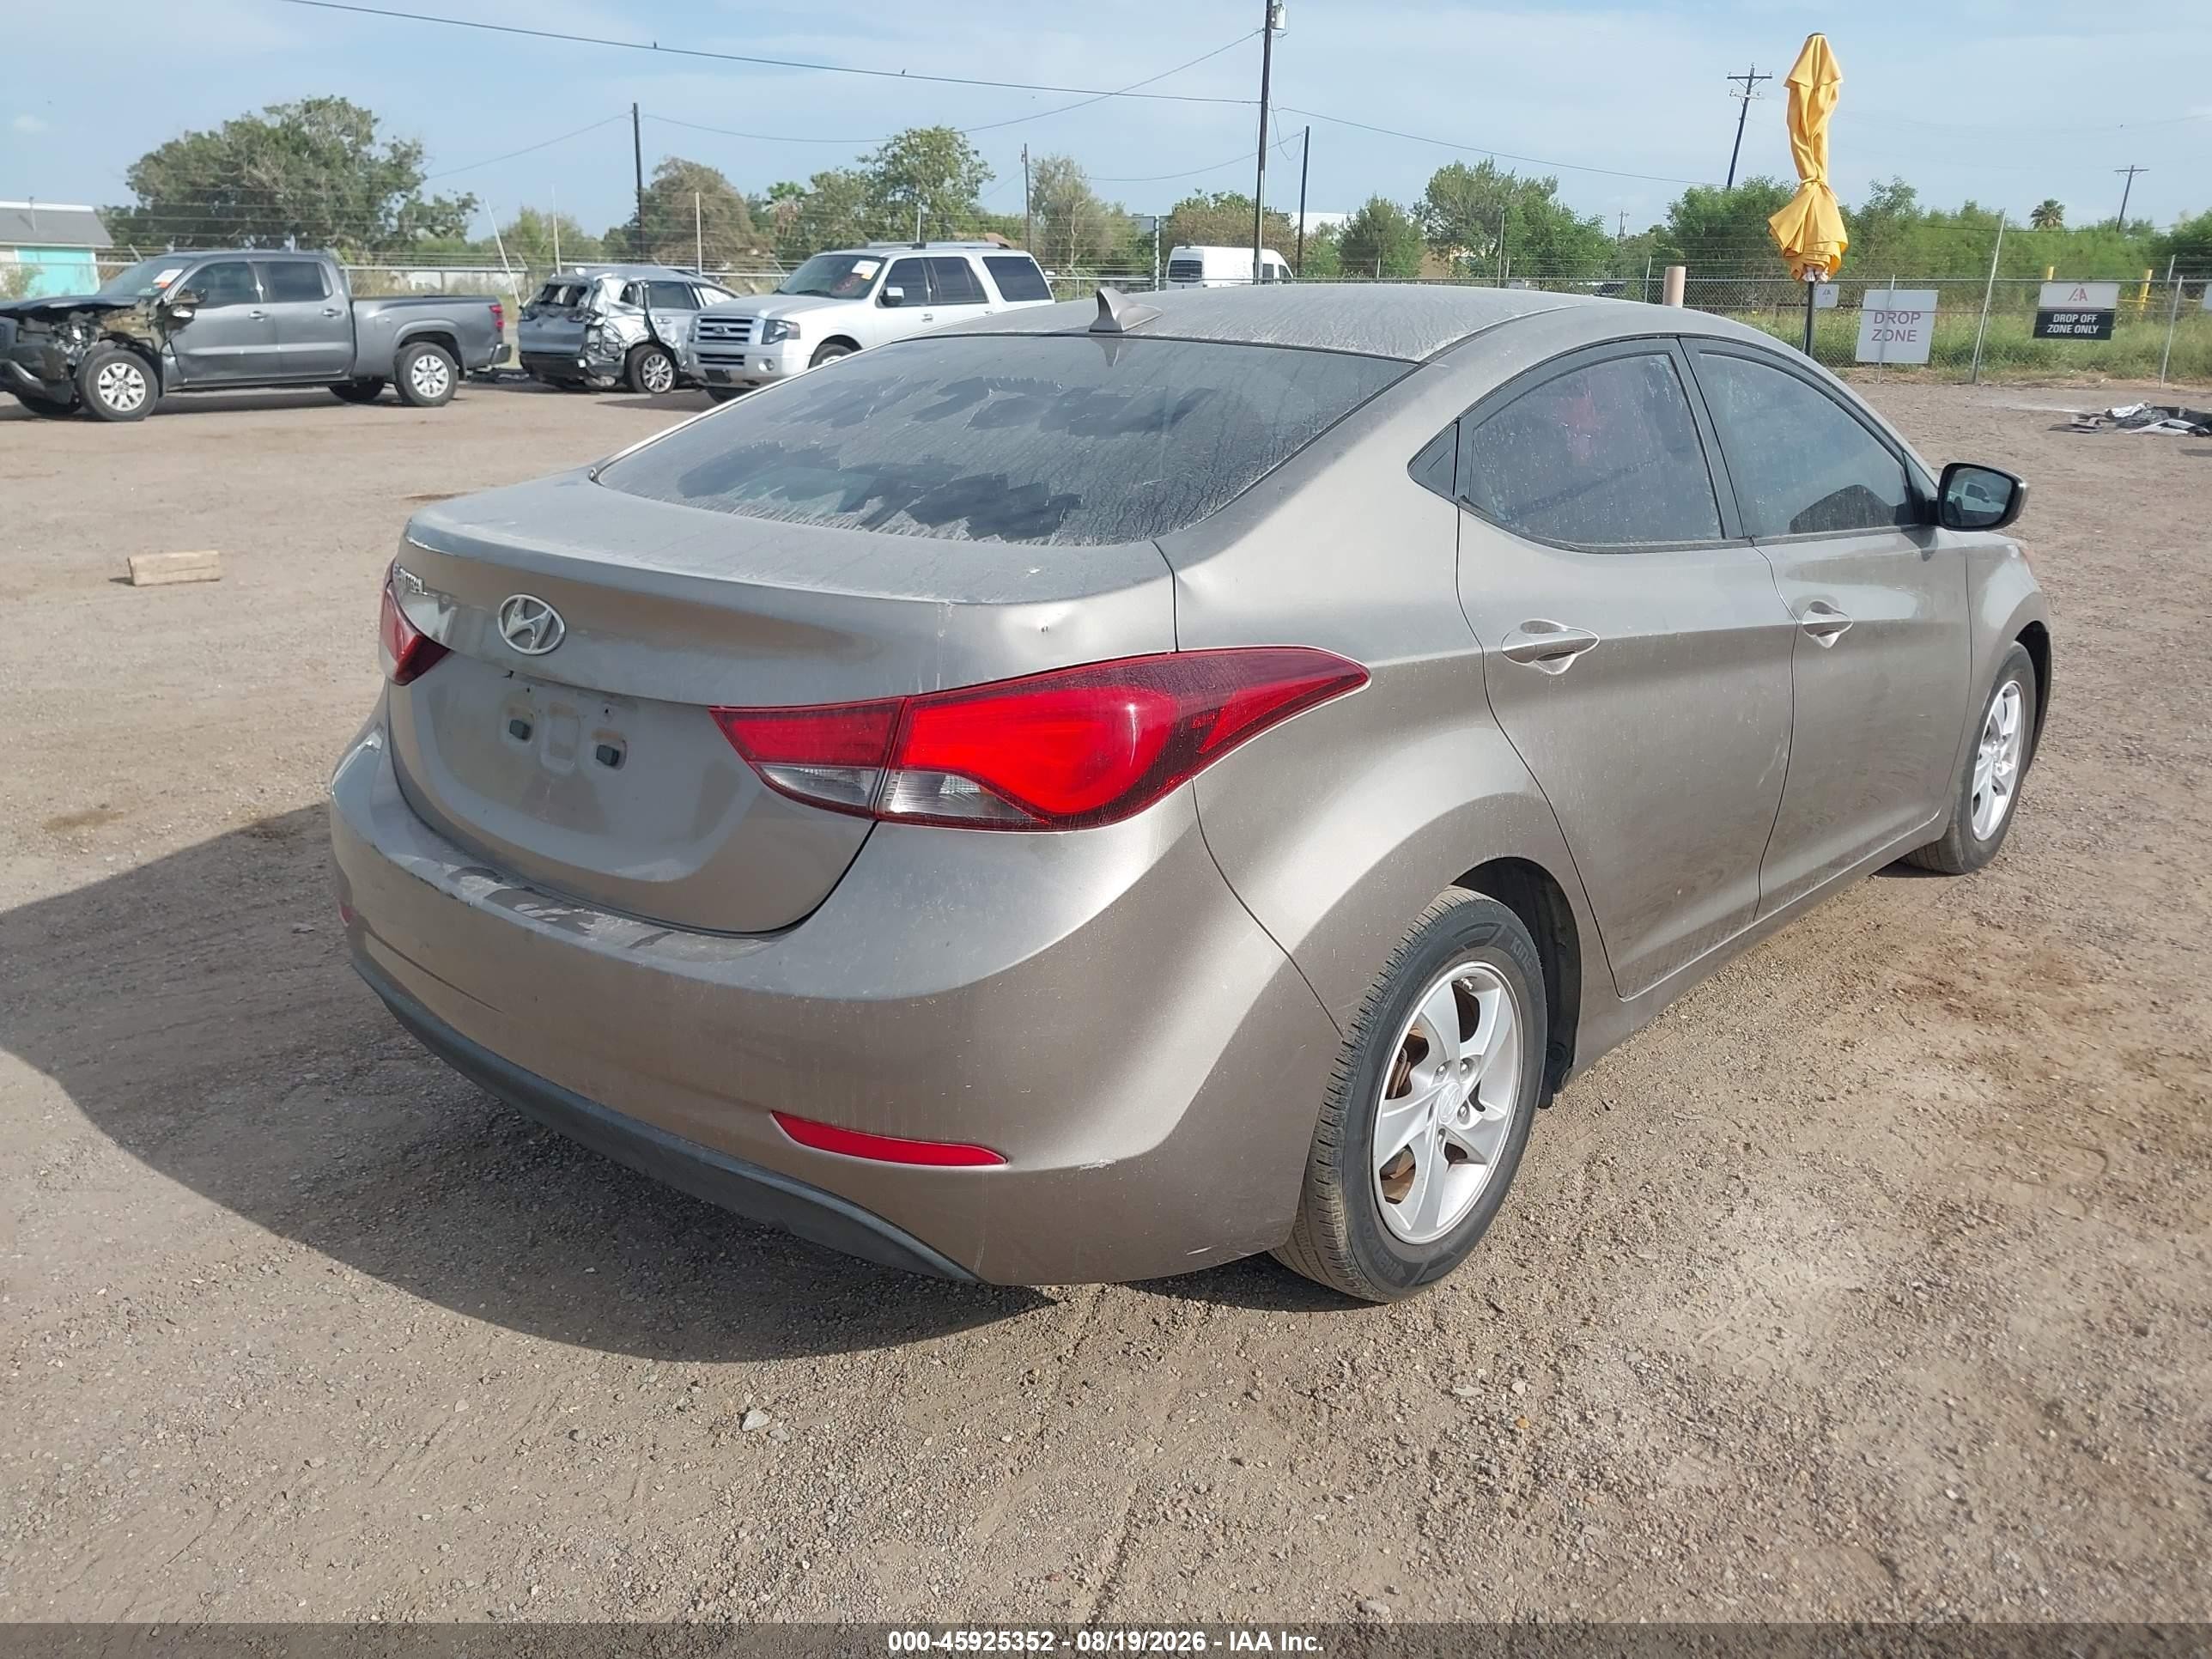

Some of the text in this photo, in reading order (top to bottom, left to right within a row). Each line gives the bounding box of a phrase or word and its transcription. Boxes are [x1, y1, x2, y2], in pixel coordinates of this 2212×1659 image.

[1874, 312, 1922, 325] DROP
[2052, 313, 2098, 323] DROP OFF
[2046, 325, 2100, 334] ZONE ONLY
[1871, 329, 1917, 342] ZONE
